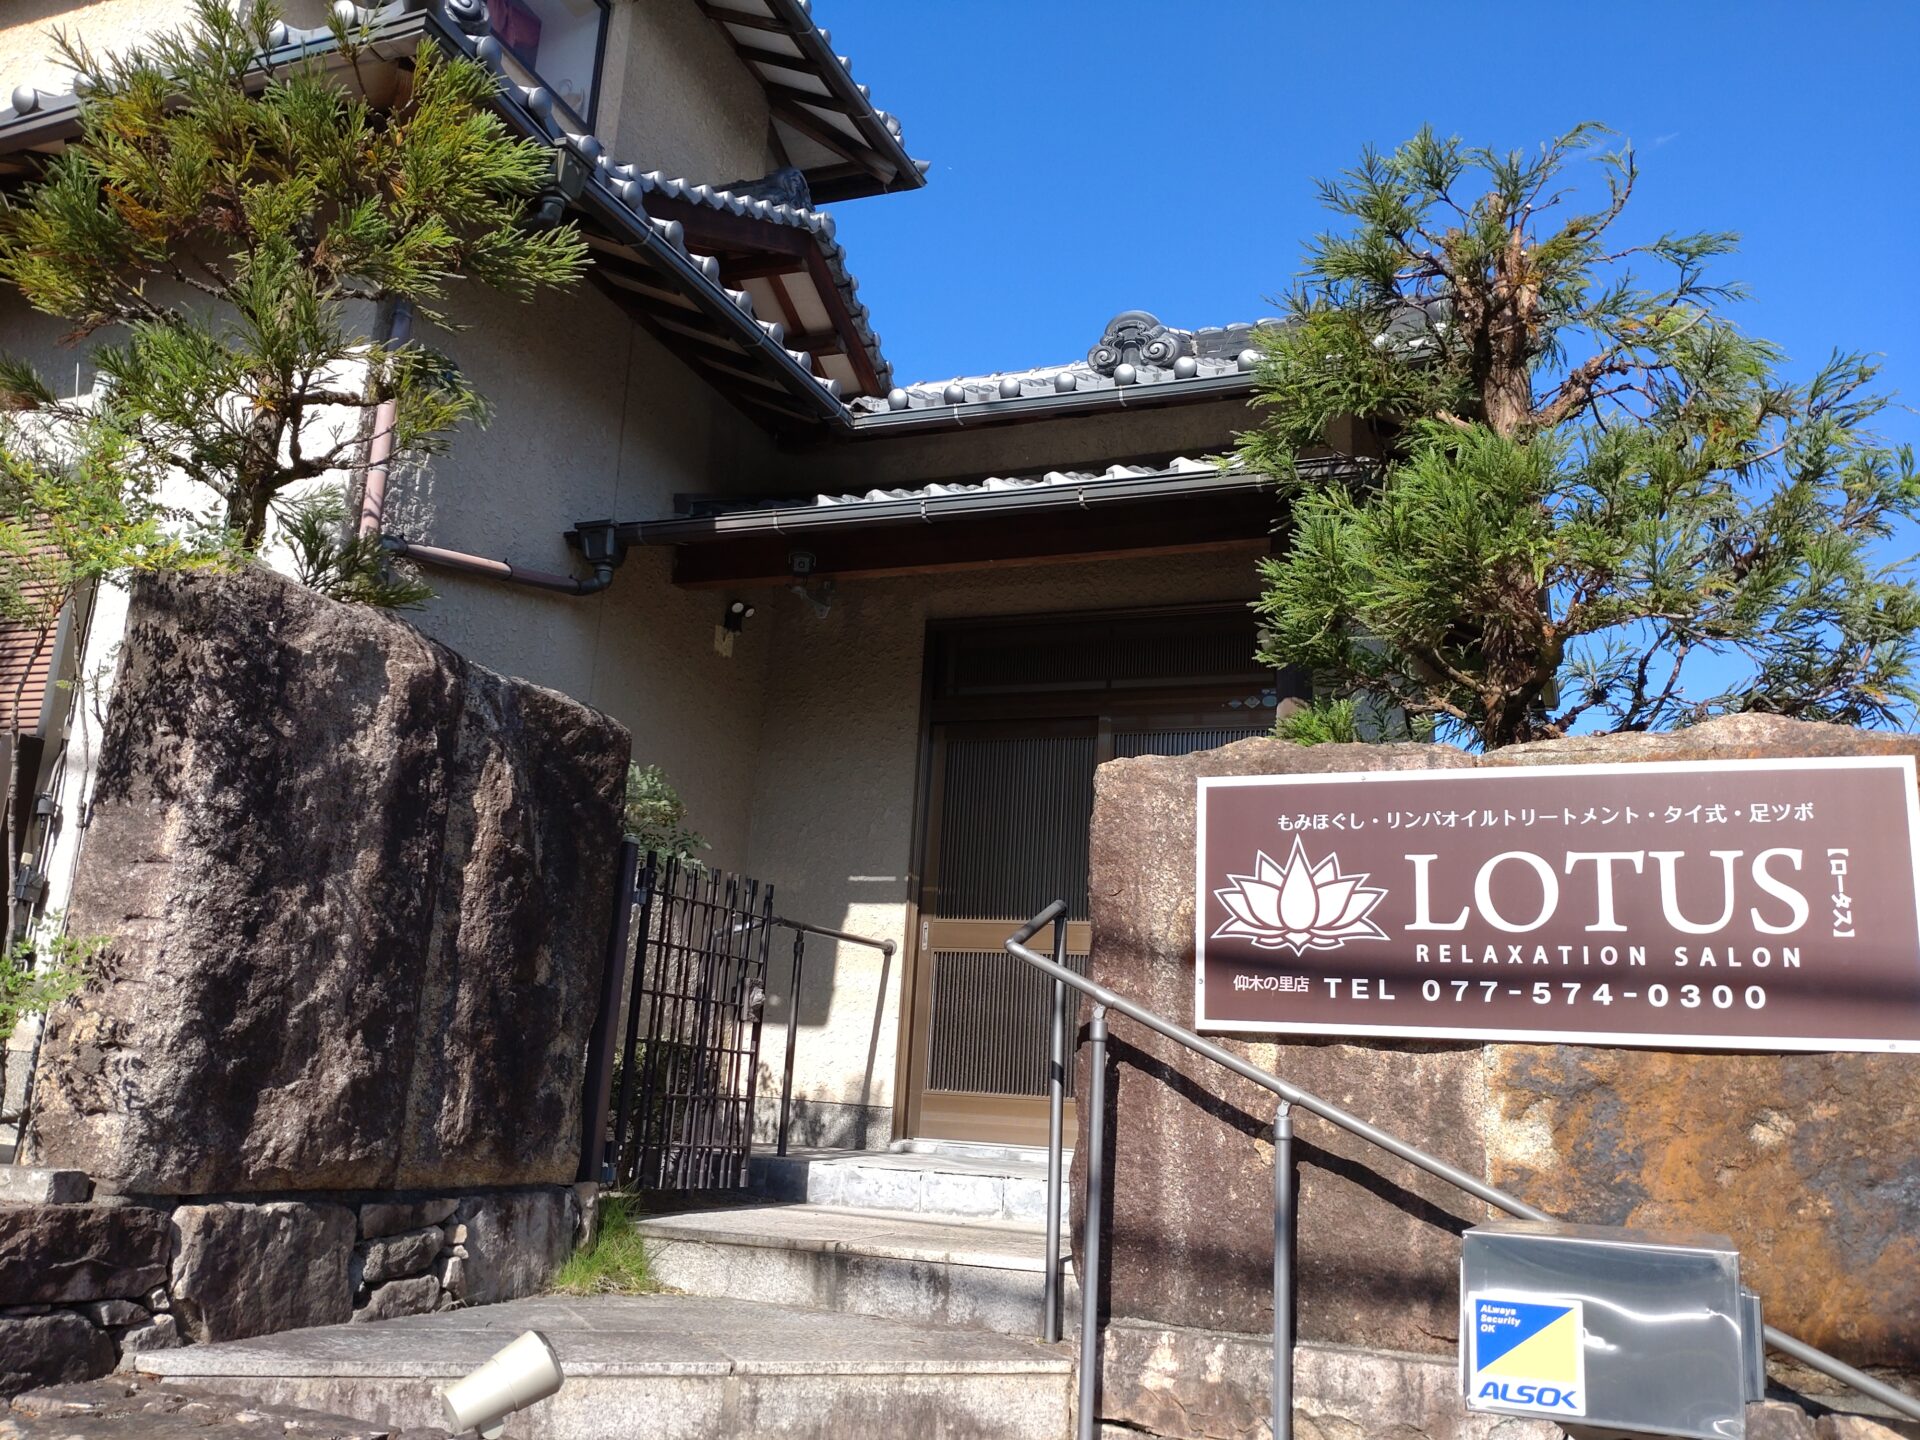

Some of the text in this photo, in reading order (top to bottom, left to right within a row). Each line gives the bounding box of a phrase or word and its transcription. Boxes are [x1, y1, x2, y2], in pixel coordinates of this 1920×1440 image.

[1404, 847, 1810, 935] LOTUS
[1416, 944, 1801, 967] RELAXATION SALON
[1233, 974, 1309, 993] 仰木の里店
[1324, 978, 1766, 1009] TEL 077-574-0300
[1480, 1314, 1521, 1327] Security
[1480, 1324, 1496, 1333] OK
[1478, 1381, 1578, 1409] ALSOK
